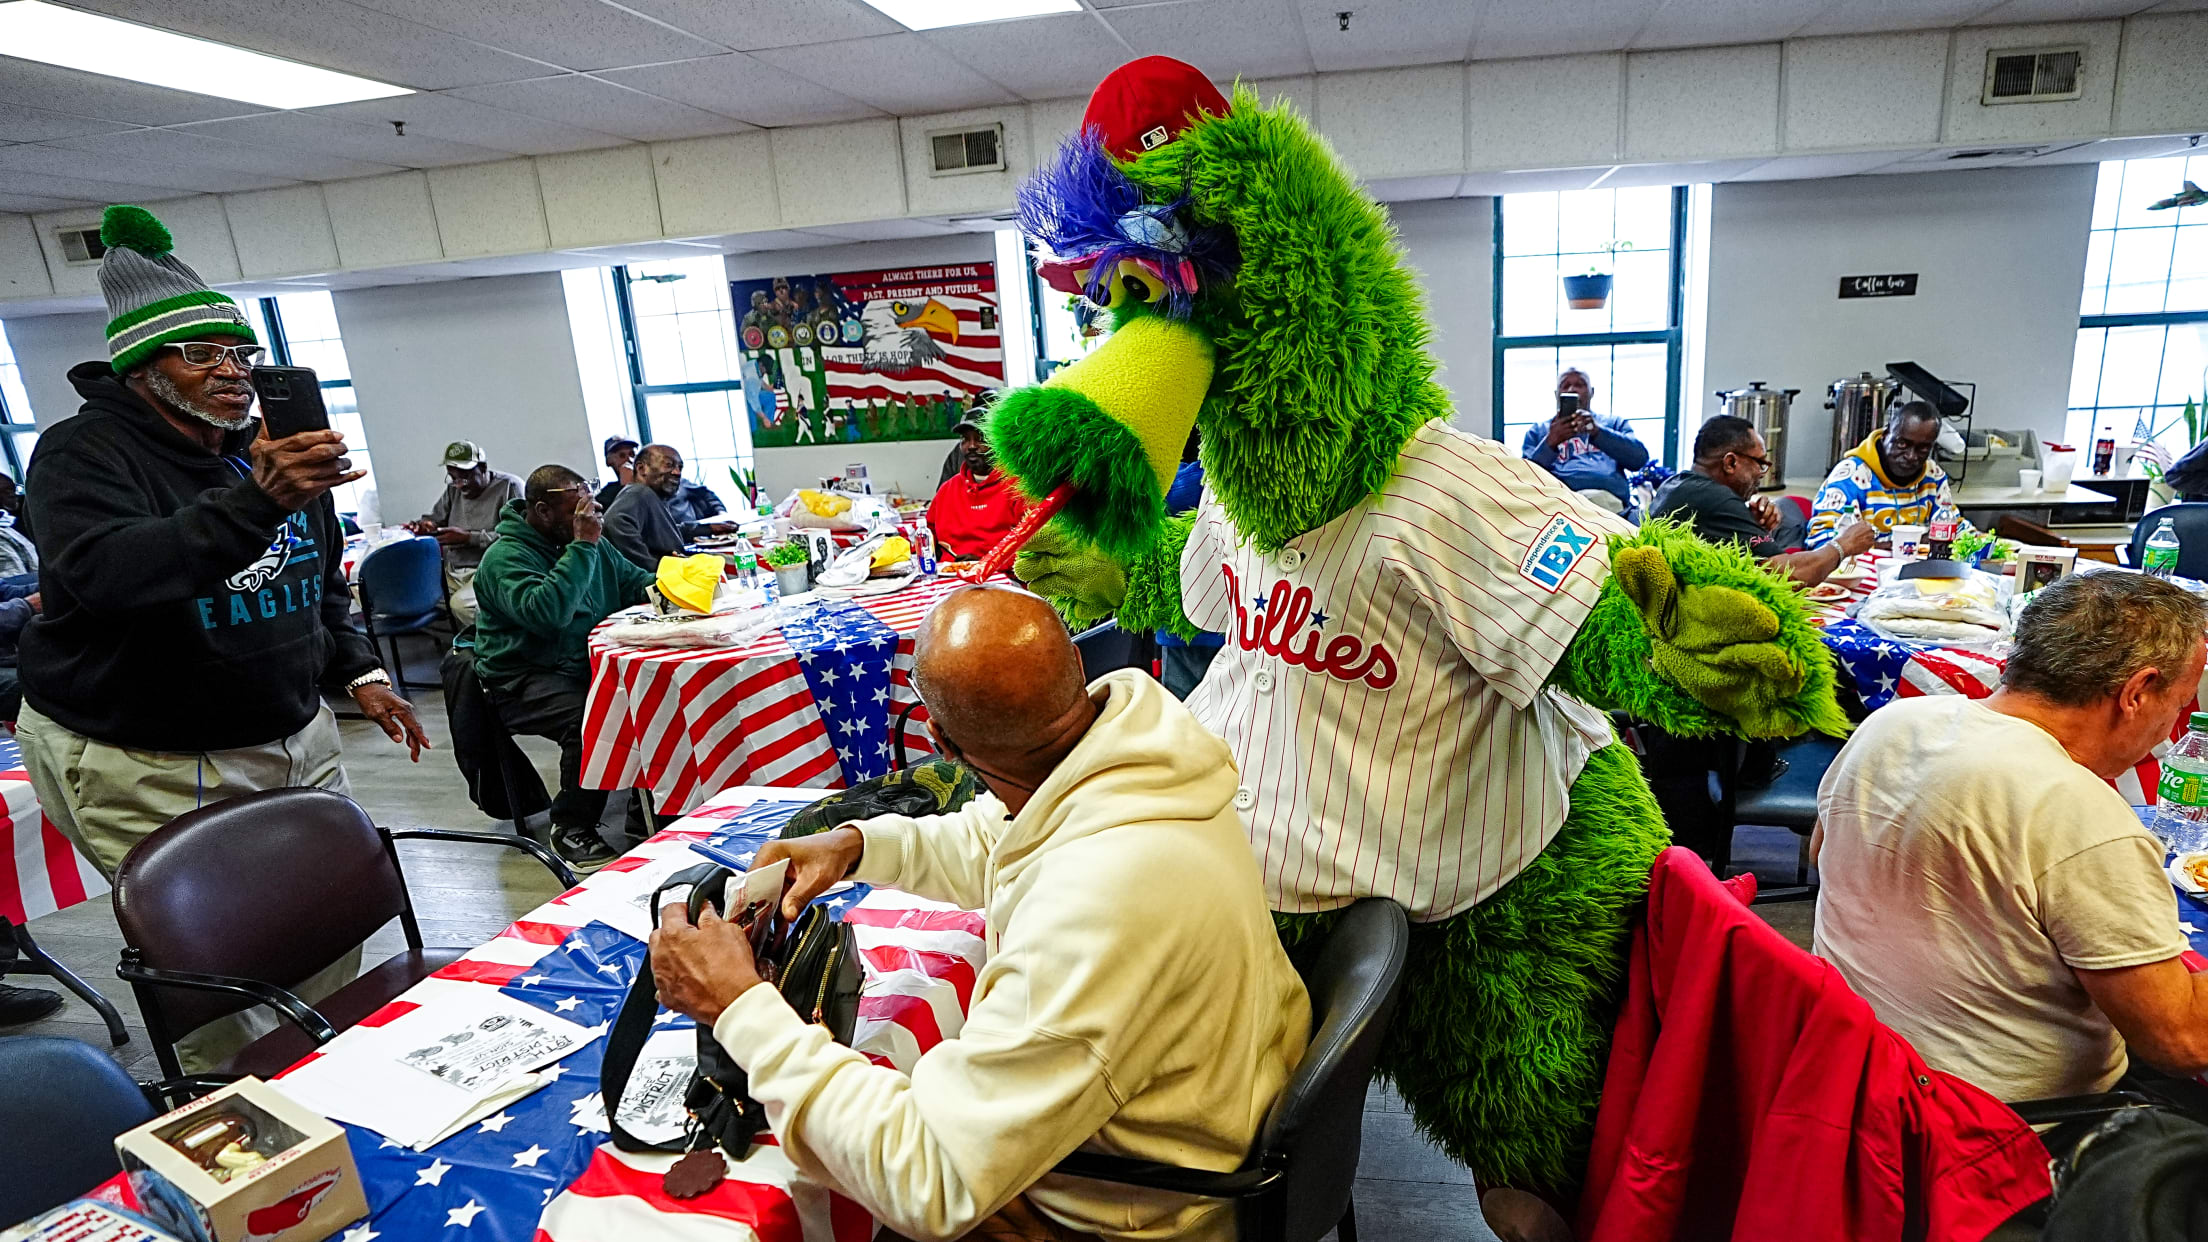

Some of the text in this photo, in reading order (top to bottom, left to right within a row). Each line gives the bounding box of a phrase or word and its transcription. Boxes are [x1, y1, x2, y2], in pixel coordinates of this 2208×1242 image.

[882, 270, 914, 282] ALWAYS
[915, 268, 943, 279] THERE
[945, 267, 962, 277] FOR
[1854, 276, 1905, 292] Coffee bar
[887, 287, 923, 299] PRESENT
[925, 286, 943, 296] AND
[945, 283, 982, 295] FUTURE.
[802, 356, 813, 366] IN
[846, 350, 876, 363] THERE
[880, 351, 887, 361] IS
[1523, 524, 1558, 573] Independence
[1531, 523, 1592, 587] IBX
[196, 574, 321, 630] EAGLES
[2159, 765, 2185, 789] ite
[632, 1079, 655, 1102] POLICE
[633, 1070, 674, 1114] DISTRICT
